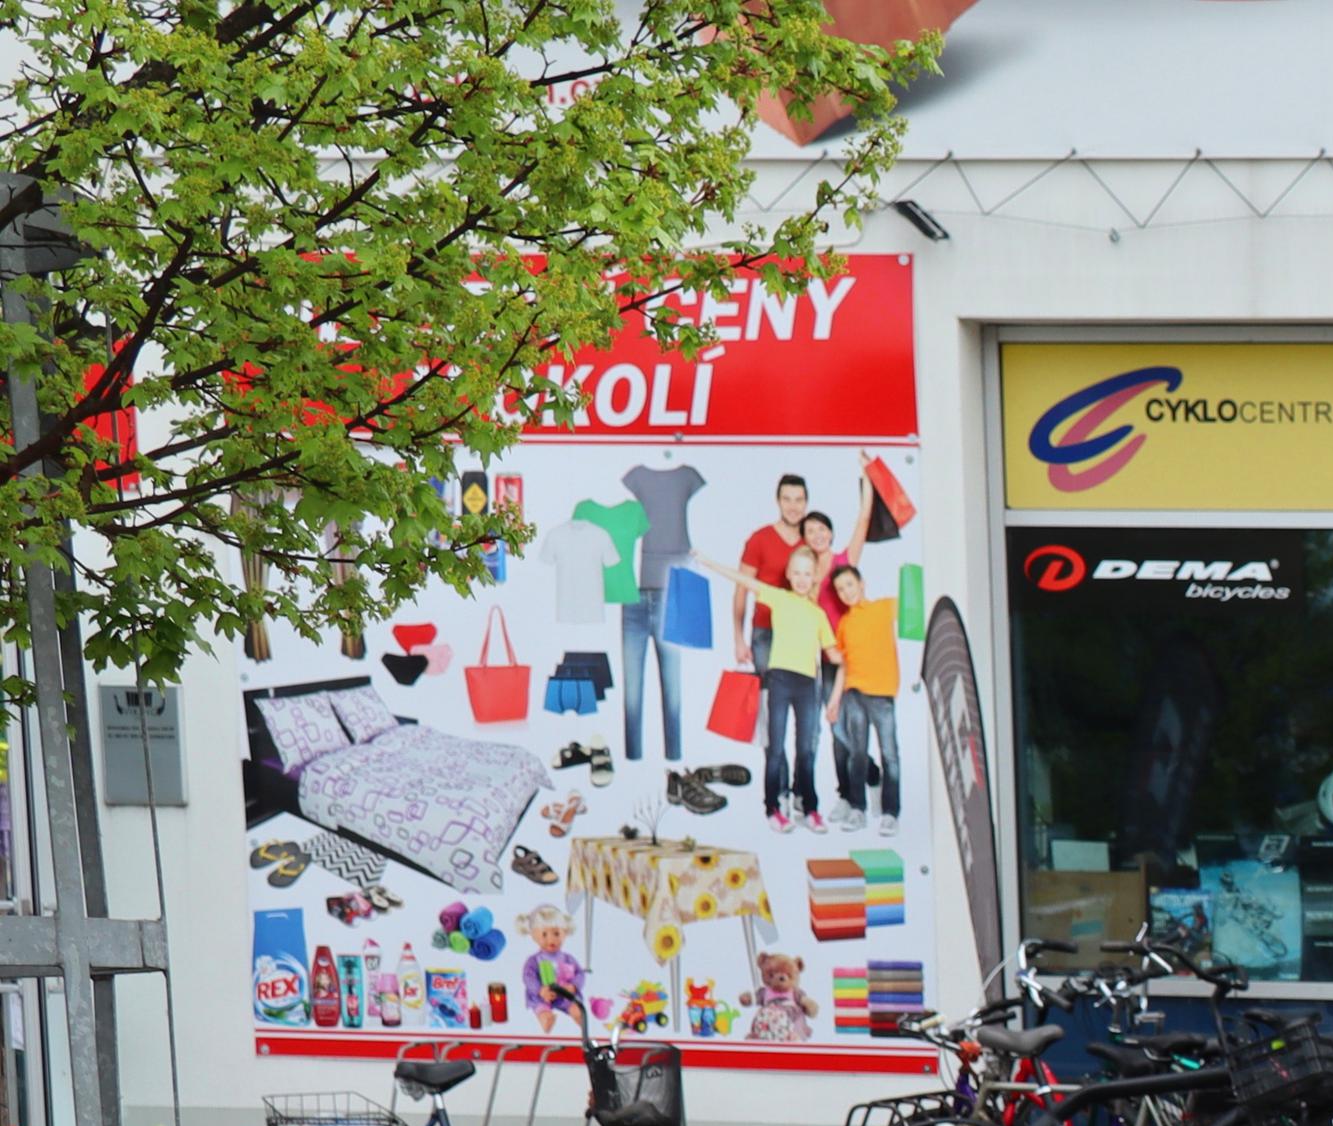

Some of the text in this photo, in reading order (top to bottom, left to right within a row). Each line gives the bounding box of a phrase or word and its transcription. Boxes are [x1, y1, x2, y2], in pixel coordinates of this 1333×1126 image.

[1092, 559, 1273, 581] DEMA
[1184, 581, 1291, 603] bicycles
[256, 975, 299, 1000] REX
